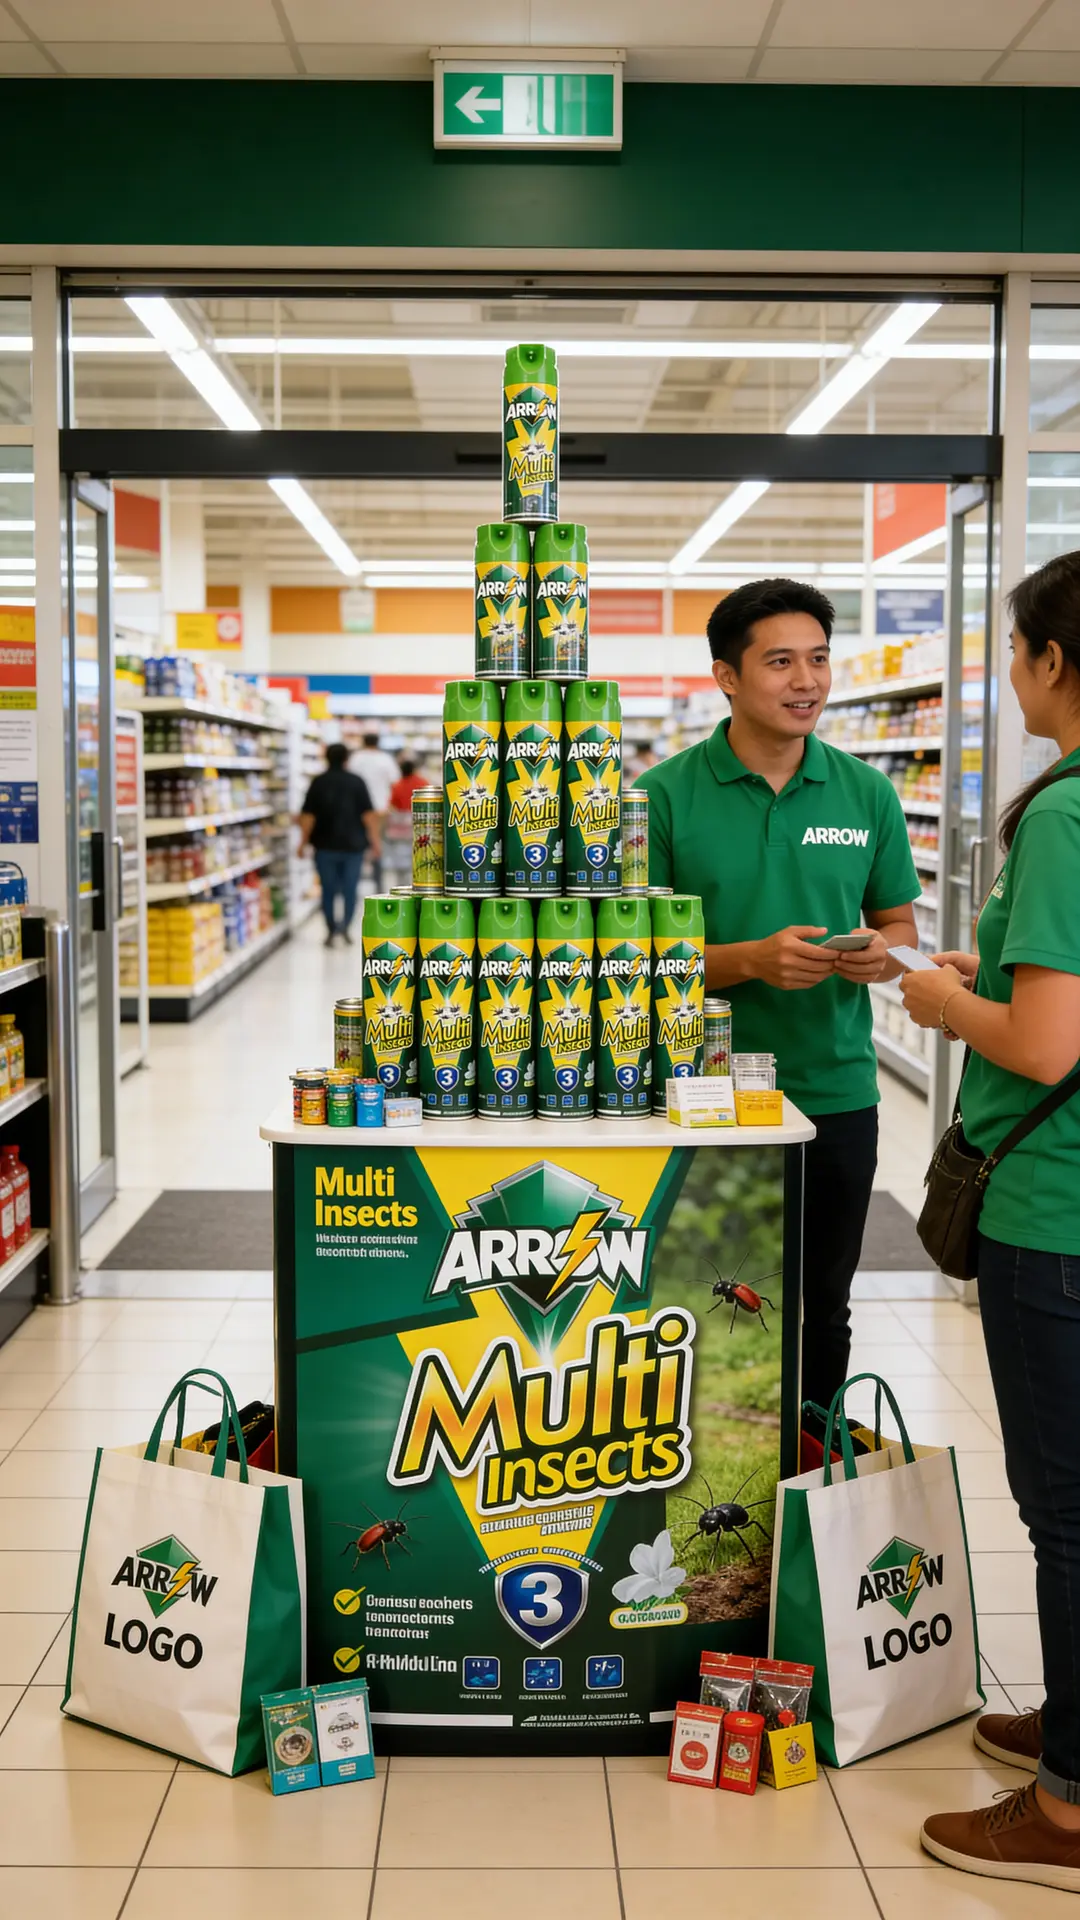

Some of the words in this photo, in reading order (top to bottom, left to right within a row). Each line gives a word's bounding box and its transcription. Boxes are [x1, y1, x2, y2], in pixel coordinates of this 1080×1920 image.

[508, 452, 555, 481] Multi
[448, 797, 498, 826] Multi
[509, 797, 559, 826] Multi
[571, 797, 620, 826] Multi
[801, 826, 870, 848] ARROW
[468, 848, 480, 863] 3
[529, 848, 542, 863] 3
[591, 848, 604, 863] 3
[365, 1015, 413, 1045] Multi
[421, 1016, 471, 1046] Multi
[481, 1016, 531, 1047] Multi
[540, 1016, 592, 1047] Multi
[600, 1015, 650, 1046] Multi
[658, 1012, 704, 1045] Multi
[384, 1068, 395, 1083] 3
[441, 1069, 454, 1085] 3
[501, 1070, 513, 1086] 3
[561, 1070, 573, 1086] 3
[621, 1069, 634, 1085] 3
[678, 1066, 690, 1078] 3
[315, 1166, 395, 1197] Multi
[315, 1199, 419, 1227] Insects
[431, 1227, 648, 1296] ARROW
[396, 1316, 688, 1478] Multi
[110, 1555, 219, 1608] ARRW
[856, 1553, 944, 1611] ARRW
[518, 1571, 564, 1627] 3
[103, 1611, 204, 1670] LOGO
[863, 1612, 953, 1671] LOGO
